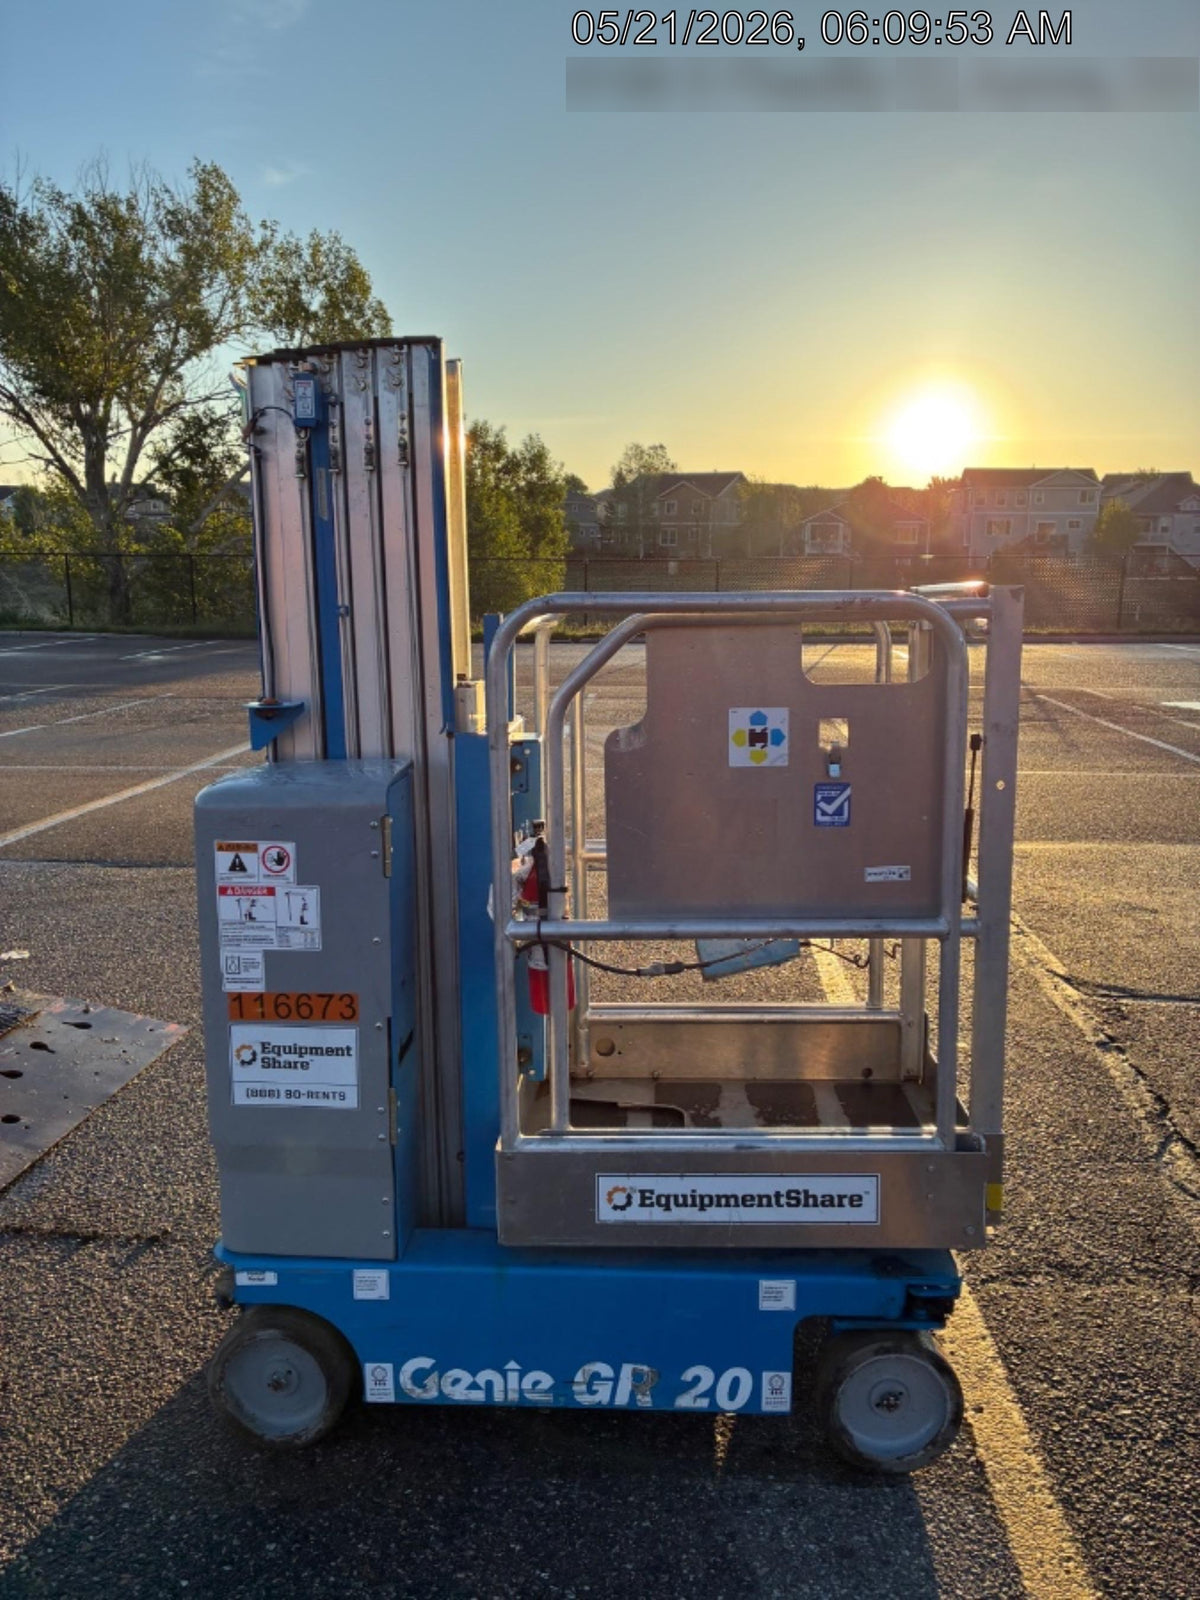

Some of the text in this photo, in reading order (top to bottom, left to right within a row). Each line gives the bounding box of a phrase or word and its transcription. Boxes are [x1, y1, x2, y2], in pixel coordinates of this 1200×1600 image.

[232, 993, 357, 1020] 116673
[260, 1041, 353, 1058] Equipment
[260, 1057, 310, 1071] Share
[637, 1188, 864, 1212] EquipmentShare
[399, 1355, 556, 1402] Genie
[674, 1365, 753, 1412] 20
